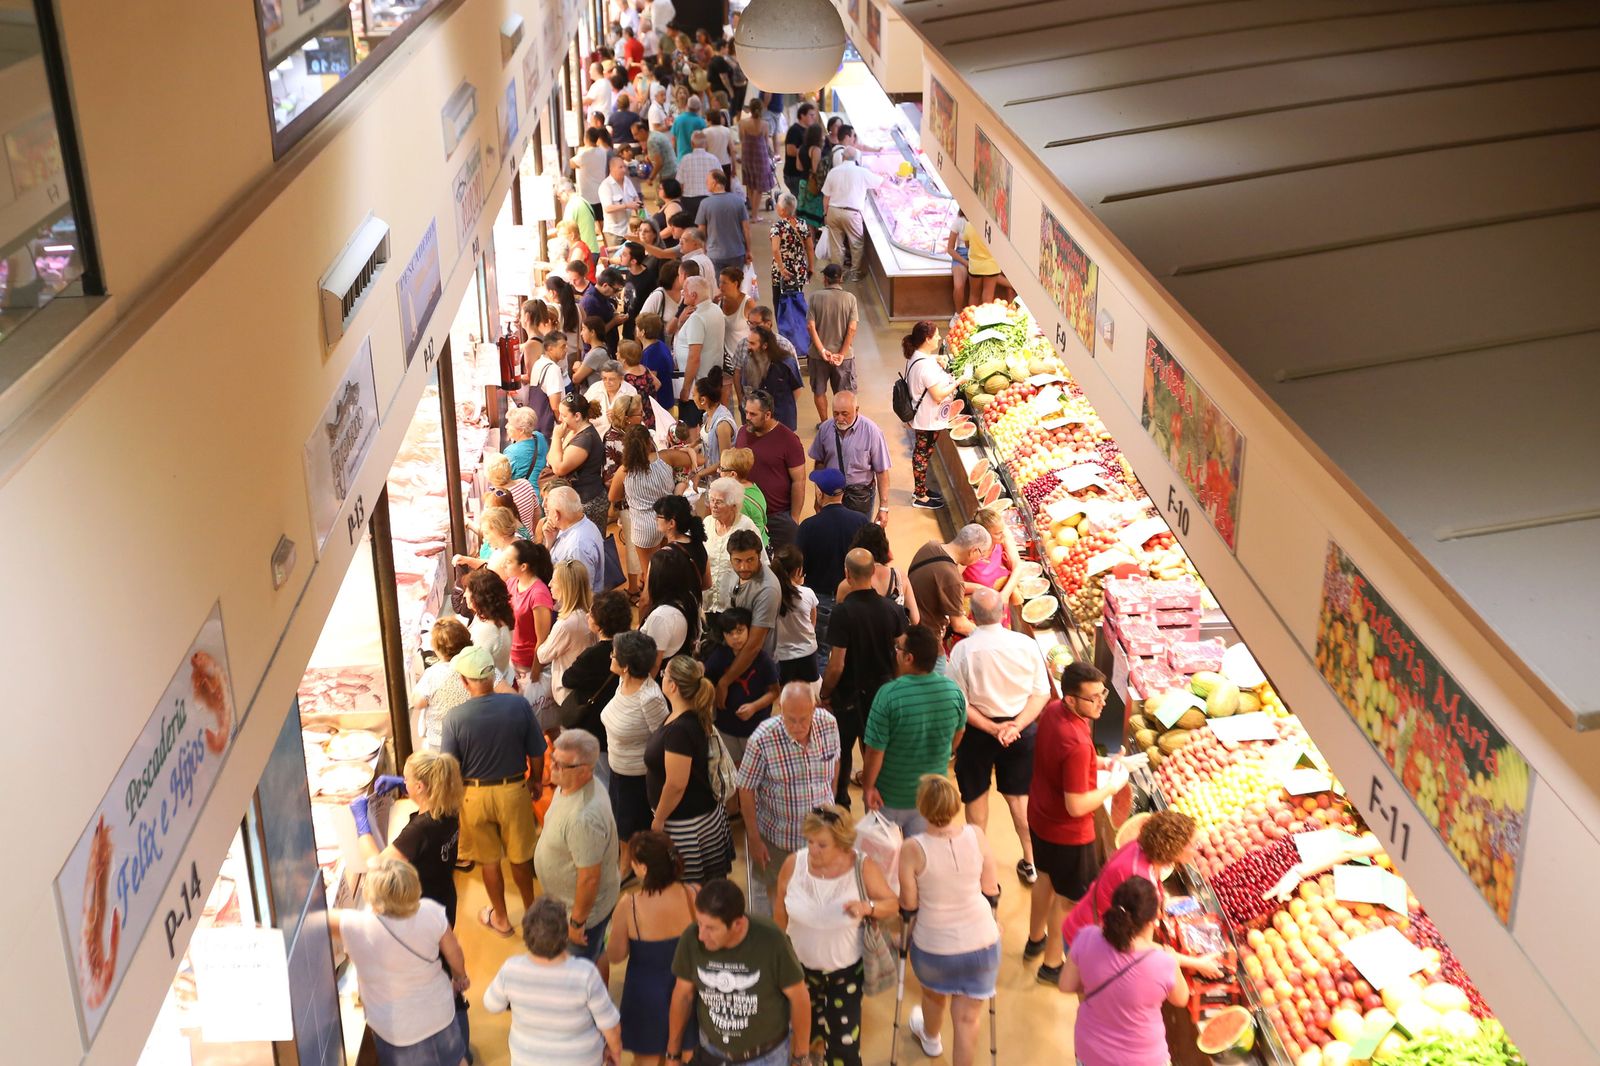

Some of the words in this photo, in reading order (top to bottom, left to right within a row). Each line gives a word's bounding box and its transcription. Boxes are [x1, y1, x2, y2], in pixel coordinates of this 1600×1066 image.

[423, 336, 435, 373] P-12
[1055, 321, 1067, 353] F-9
[347, 494, 365, 546] P-13
[1167, 484, 1190, 537] F-10
[1352, 575, 1426, 689] Fruteria
[1433, 676, 1500, 778] Maria
[125, 698, 187, 827] Pescaderia
[117, 816, 163, 930] Felix
[160, 798, 170, 836] e
[170, 728, 206, 818] Hijos
[1369, 775, 1411, 862] F-11
[163, 861, 201, 959] P-14
